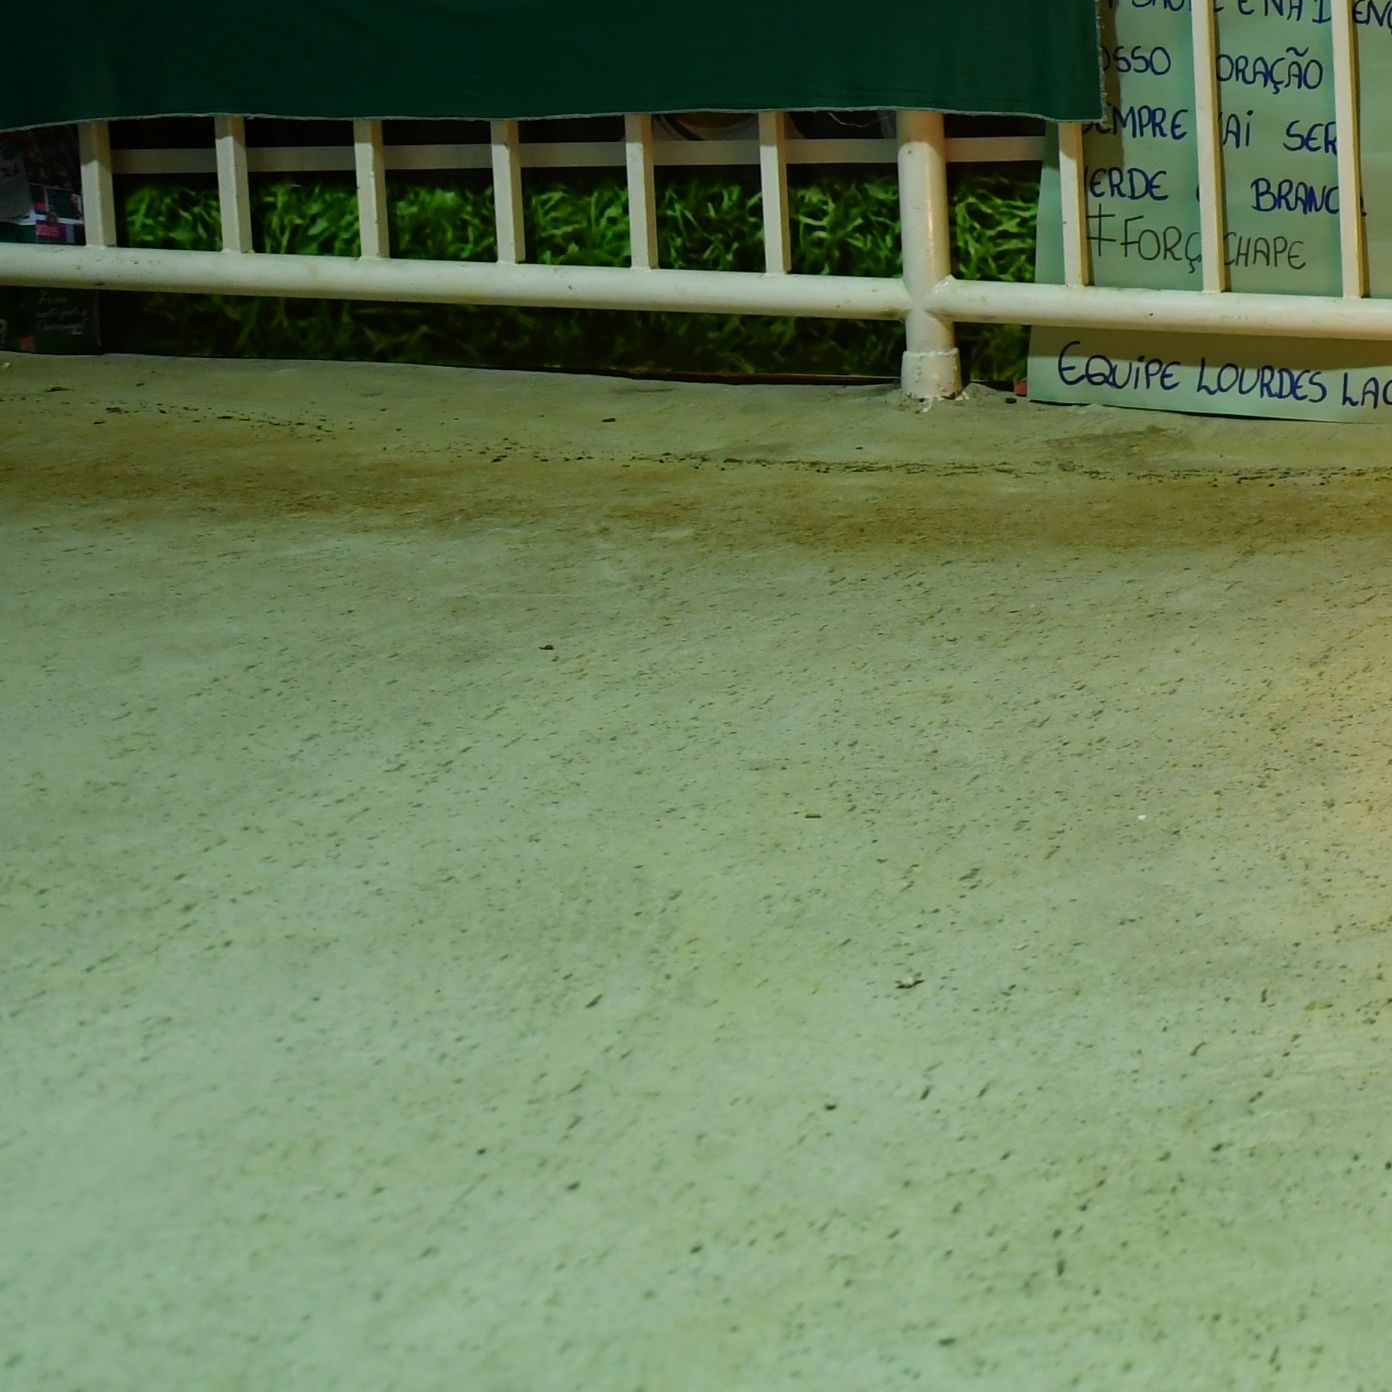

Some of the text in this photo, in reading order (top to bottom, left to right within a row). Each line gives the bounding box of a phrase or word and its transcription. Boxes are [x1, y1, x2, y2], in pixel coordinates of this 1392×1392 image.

[1214, 46, 1324, 95] ORAÇÃO
[1083, 166, 1170, 202] ERDE
[1057, 340, 1182, 392] EQUIPE
[1196, 357, 1327, 406] LOURDES
